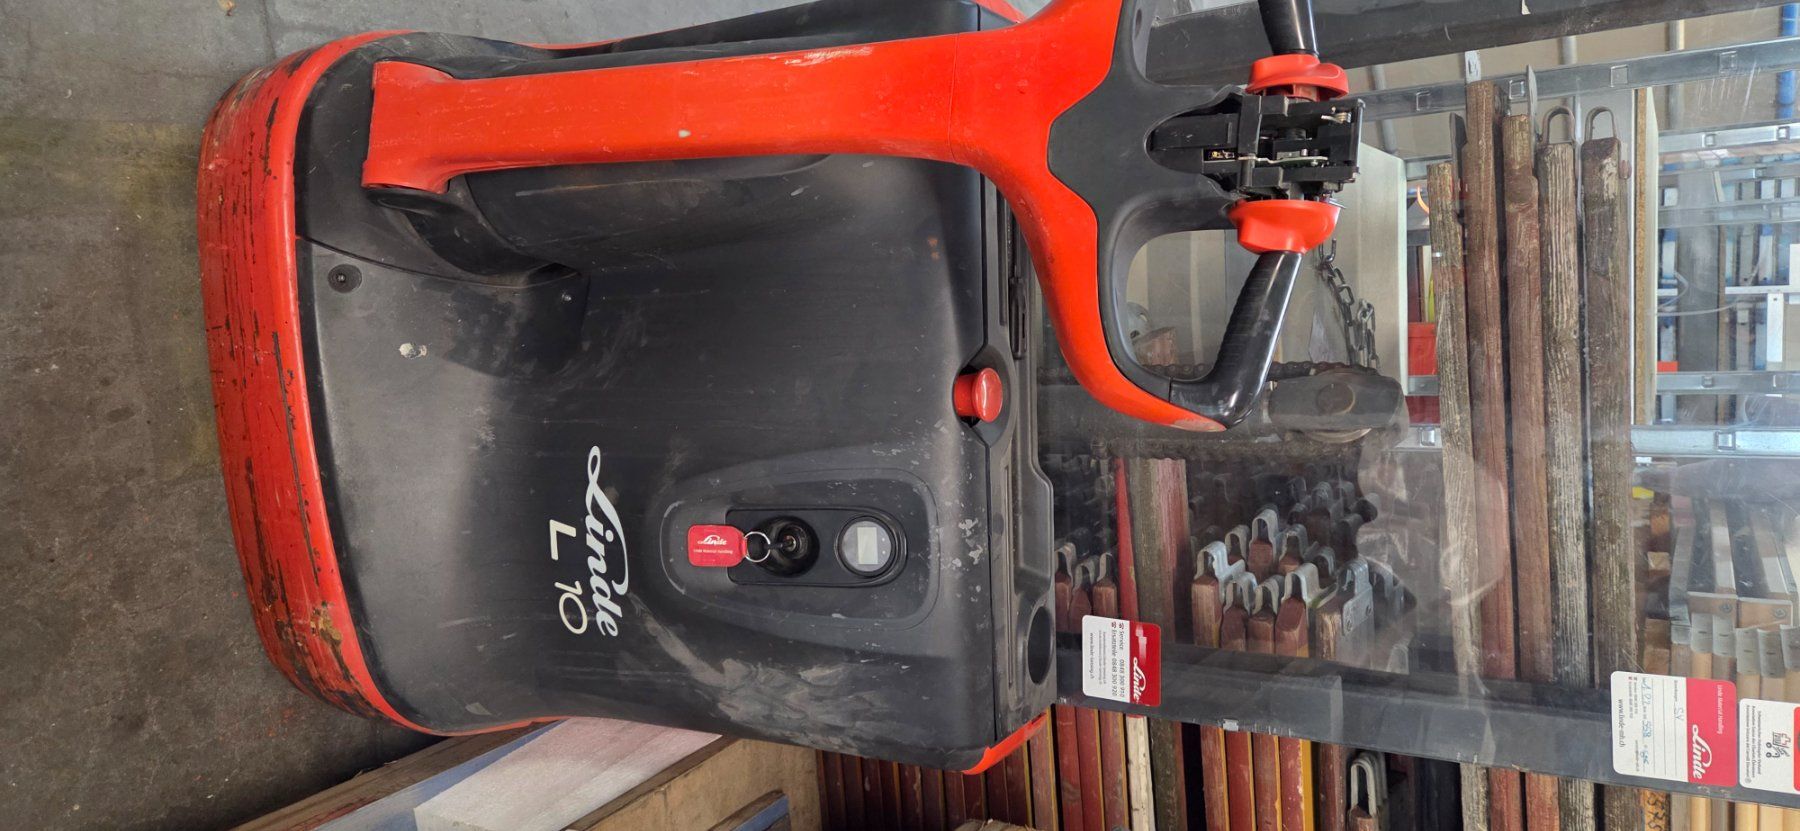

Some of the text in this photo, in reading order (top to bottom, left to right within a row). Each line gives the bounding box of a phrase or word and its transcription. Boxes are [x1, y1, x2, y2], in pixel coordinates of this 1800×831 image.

[585, 445, 629, 637] Linde
[697, 534, 727, 545] Linde
[549, 519, 587, 635] L 10
[1133, 656, 1147, 701] Linde
[1716, 715, 1724, 735] Handling
[1692, 724, 1712, 779] Linde
